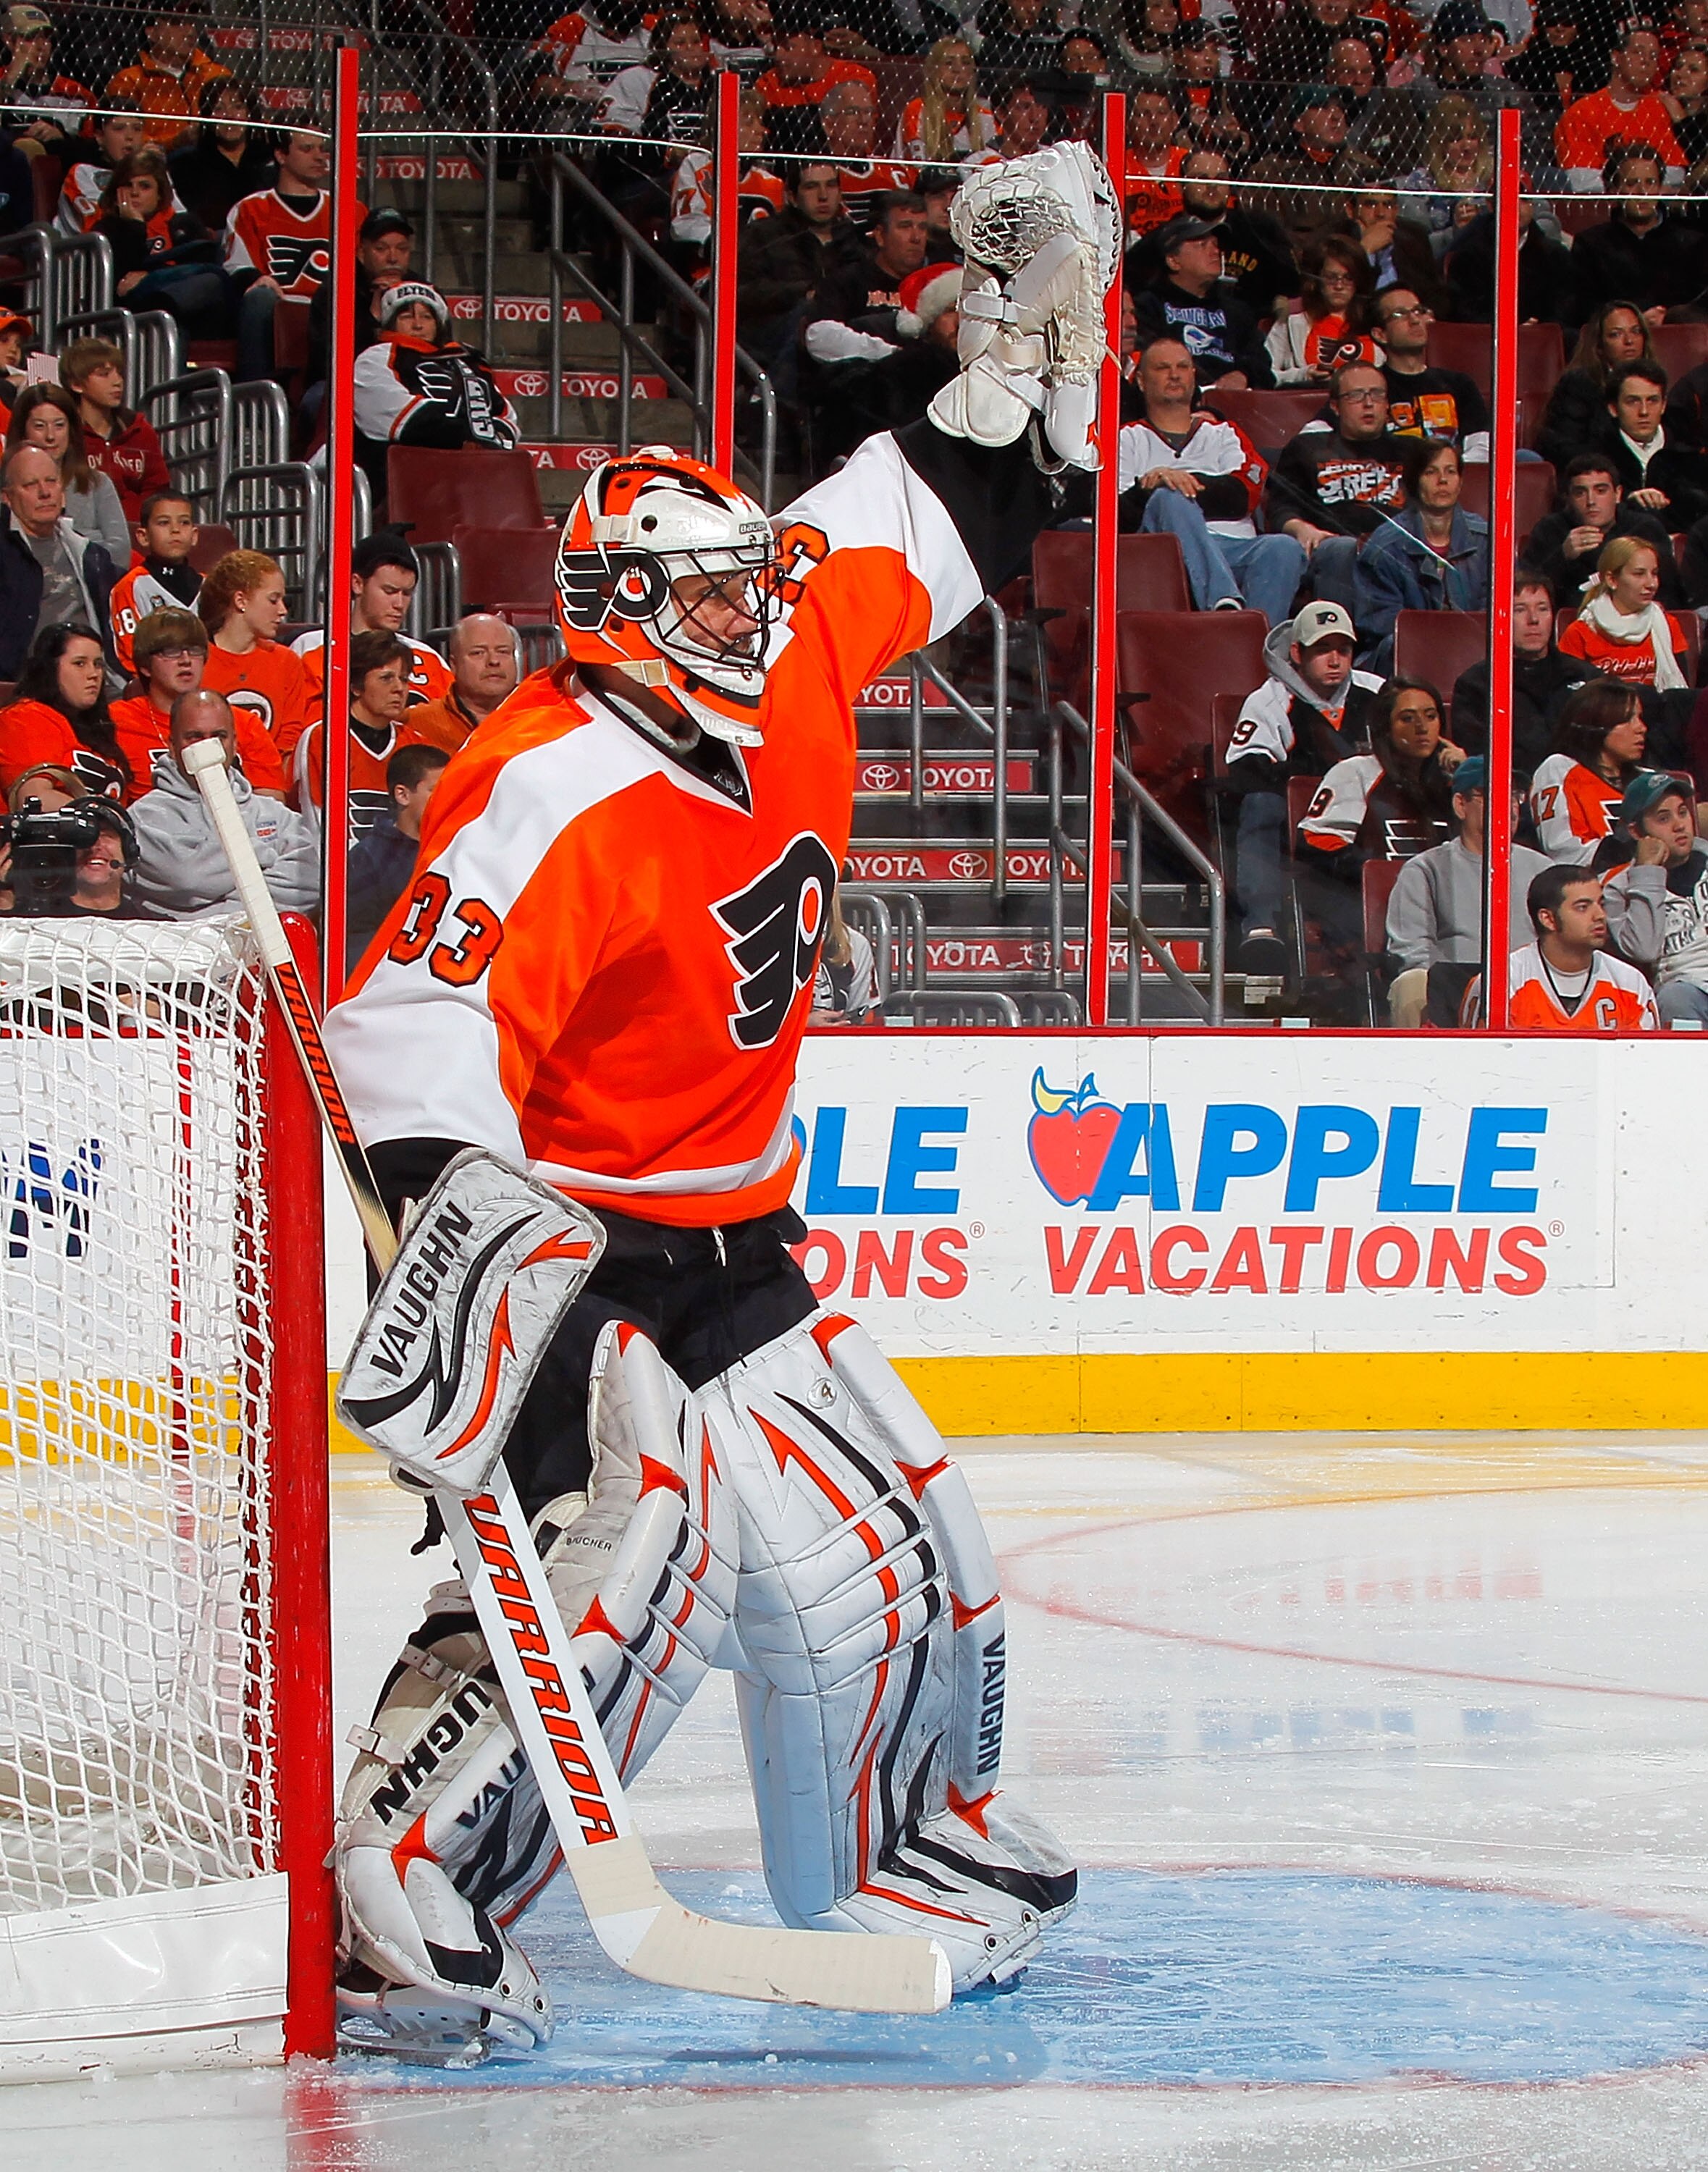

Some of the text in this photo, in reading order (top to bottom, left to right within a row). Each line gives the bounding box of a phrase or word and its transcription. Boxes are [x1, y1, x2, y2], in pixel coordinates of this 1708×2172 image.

[387, 872, 505, 987] 33
[1594, 998, 1617, 1031] C
[1084, 1103, 1549, 1213] APPLE
[369, 1200, 474, 1378] VAUGHN
[1043, 1224, 1549, 1297] VACATIONS
[565, 1536, 613, 1552] BUCHER
[461, 1491, 620, 1847] WARRIOR
[977, 1629, 1006, 1777] VAUGHN
